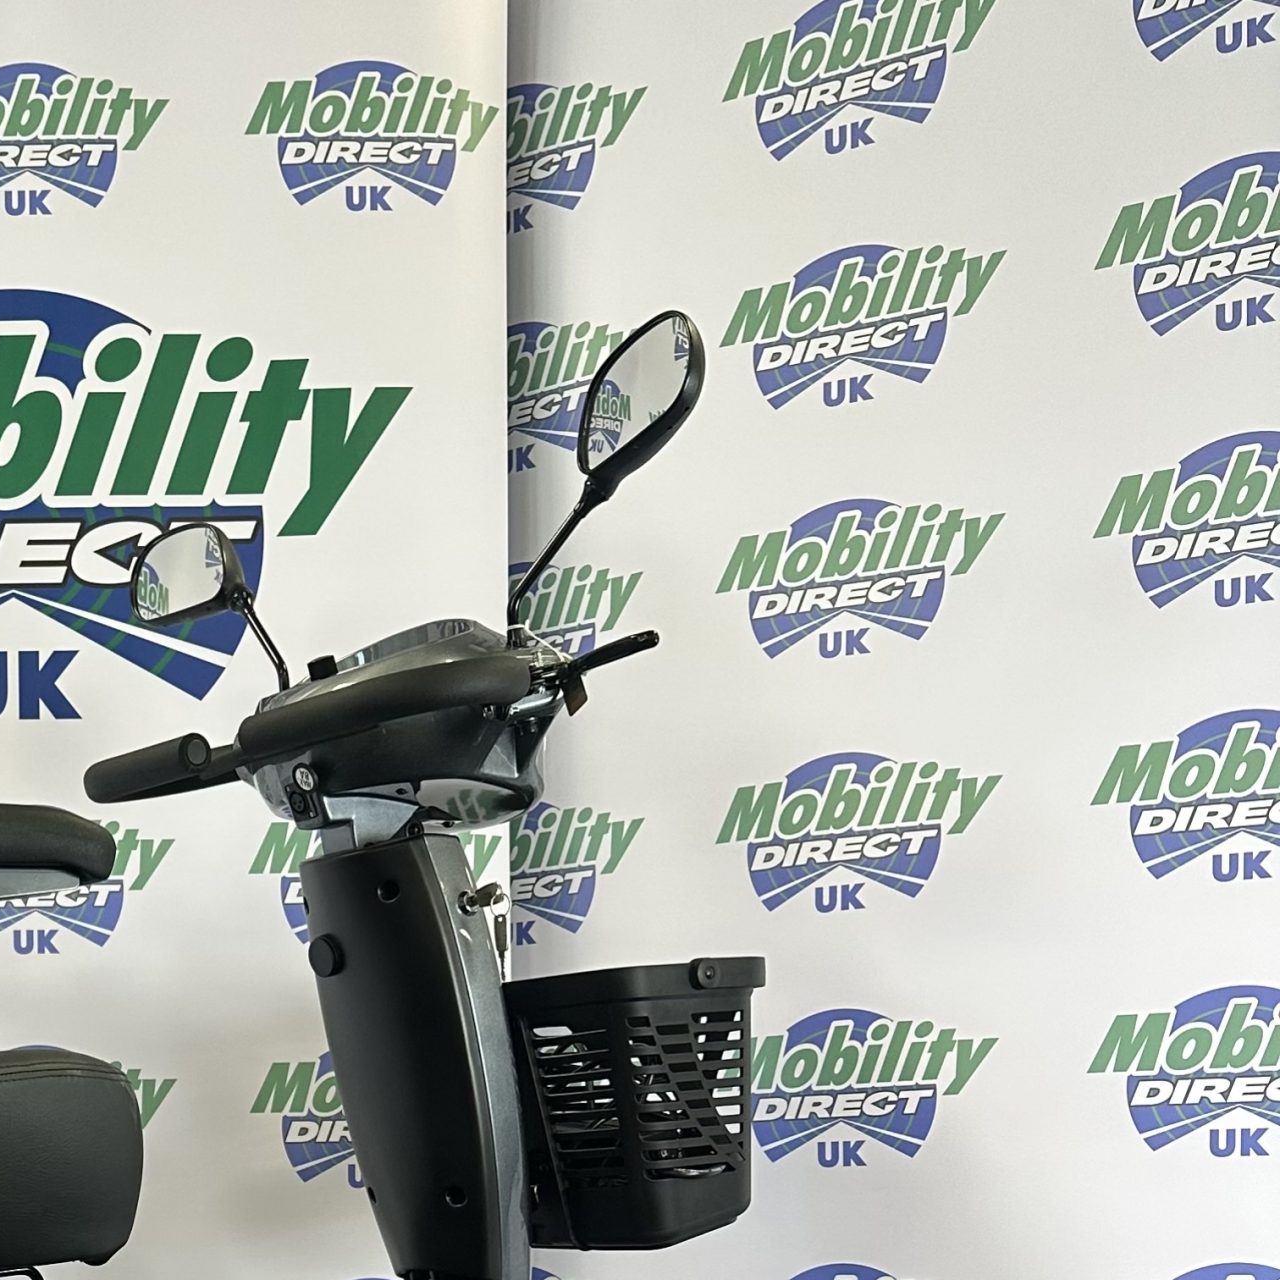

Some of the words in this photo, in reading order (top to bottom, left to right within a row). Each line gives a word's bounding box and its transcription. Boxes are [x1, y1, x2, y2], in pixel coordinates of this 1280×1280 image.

[723, 0, 997, 102] Mobility
[1215, 12, 1276, 54] UK
[759, 50, 945, 124] DIRECT
[243, 75, 500, 153] Mobility
[281, 141, 454, 165] DIRECT
[824, 116, 876, 155] UK
[508, 144, 593, 190] ECT
[4, 189, 53, 217] UK
[345, 185, 393, 212] UK
[508, 203, 534, 236] K
[1137, 242, 1280, 295] DIRE
[719, 243, 1008, 348] Mobility
[1215, 292, 1277, 332] UK
[756, 312, 945, 372] DIRECT
[822, 373, 875, 408] UK
[508, 443, 536, 475] K
[716, 502, 1006, 595] Mobility
[1135, 521, 1280, 566] DIRE
[752, 570, 942, 620] DIRECT
[1214, 571, 1275, 608] UK
[818, 627, 871, 659] UK
[715, 759, 1004, 845] Mobility
[1133, 800, 1280, 836] DIRE
[750, 829, 939, 871] DIRECT
[1212, 849, 1273, 883] UK
[510, 869, 595, 902] ECT
[814, 882, 866, 914] UK
[12, 929, 60, 955] UK
[510, 920, 537, 946] K
[752, 1089, 935, 1122] DIRECT
[817, 1139, 867, 1168] UK
[1209, 1127, 1270, 1158] UK
